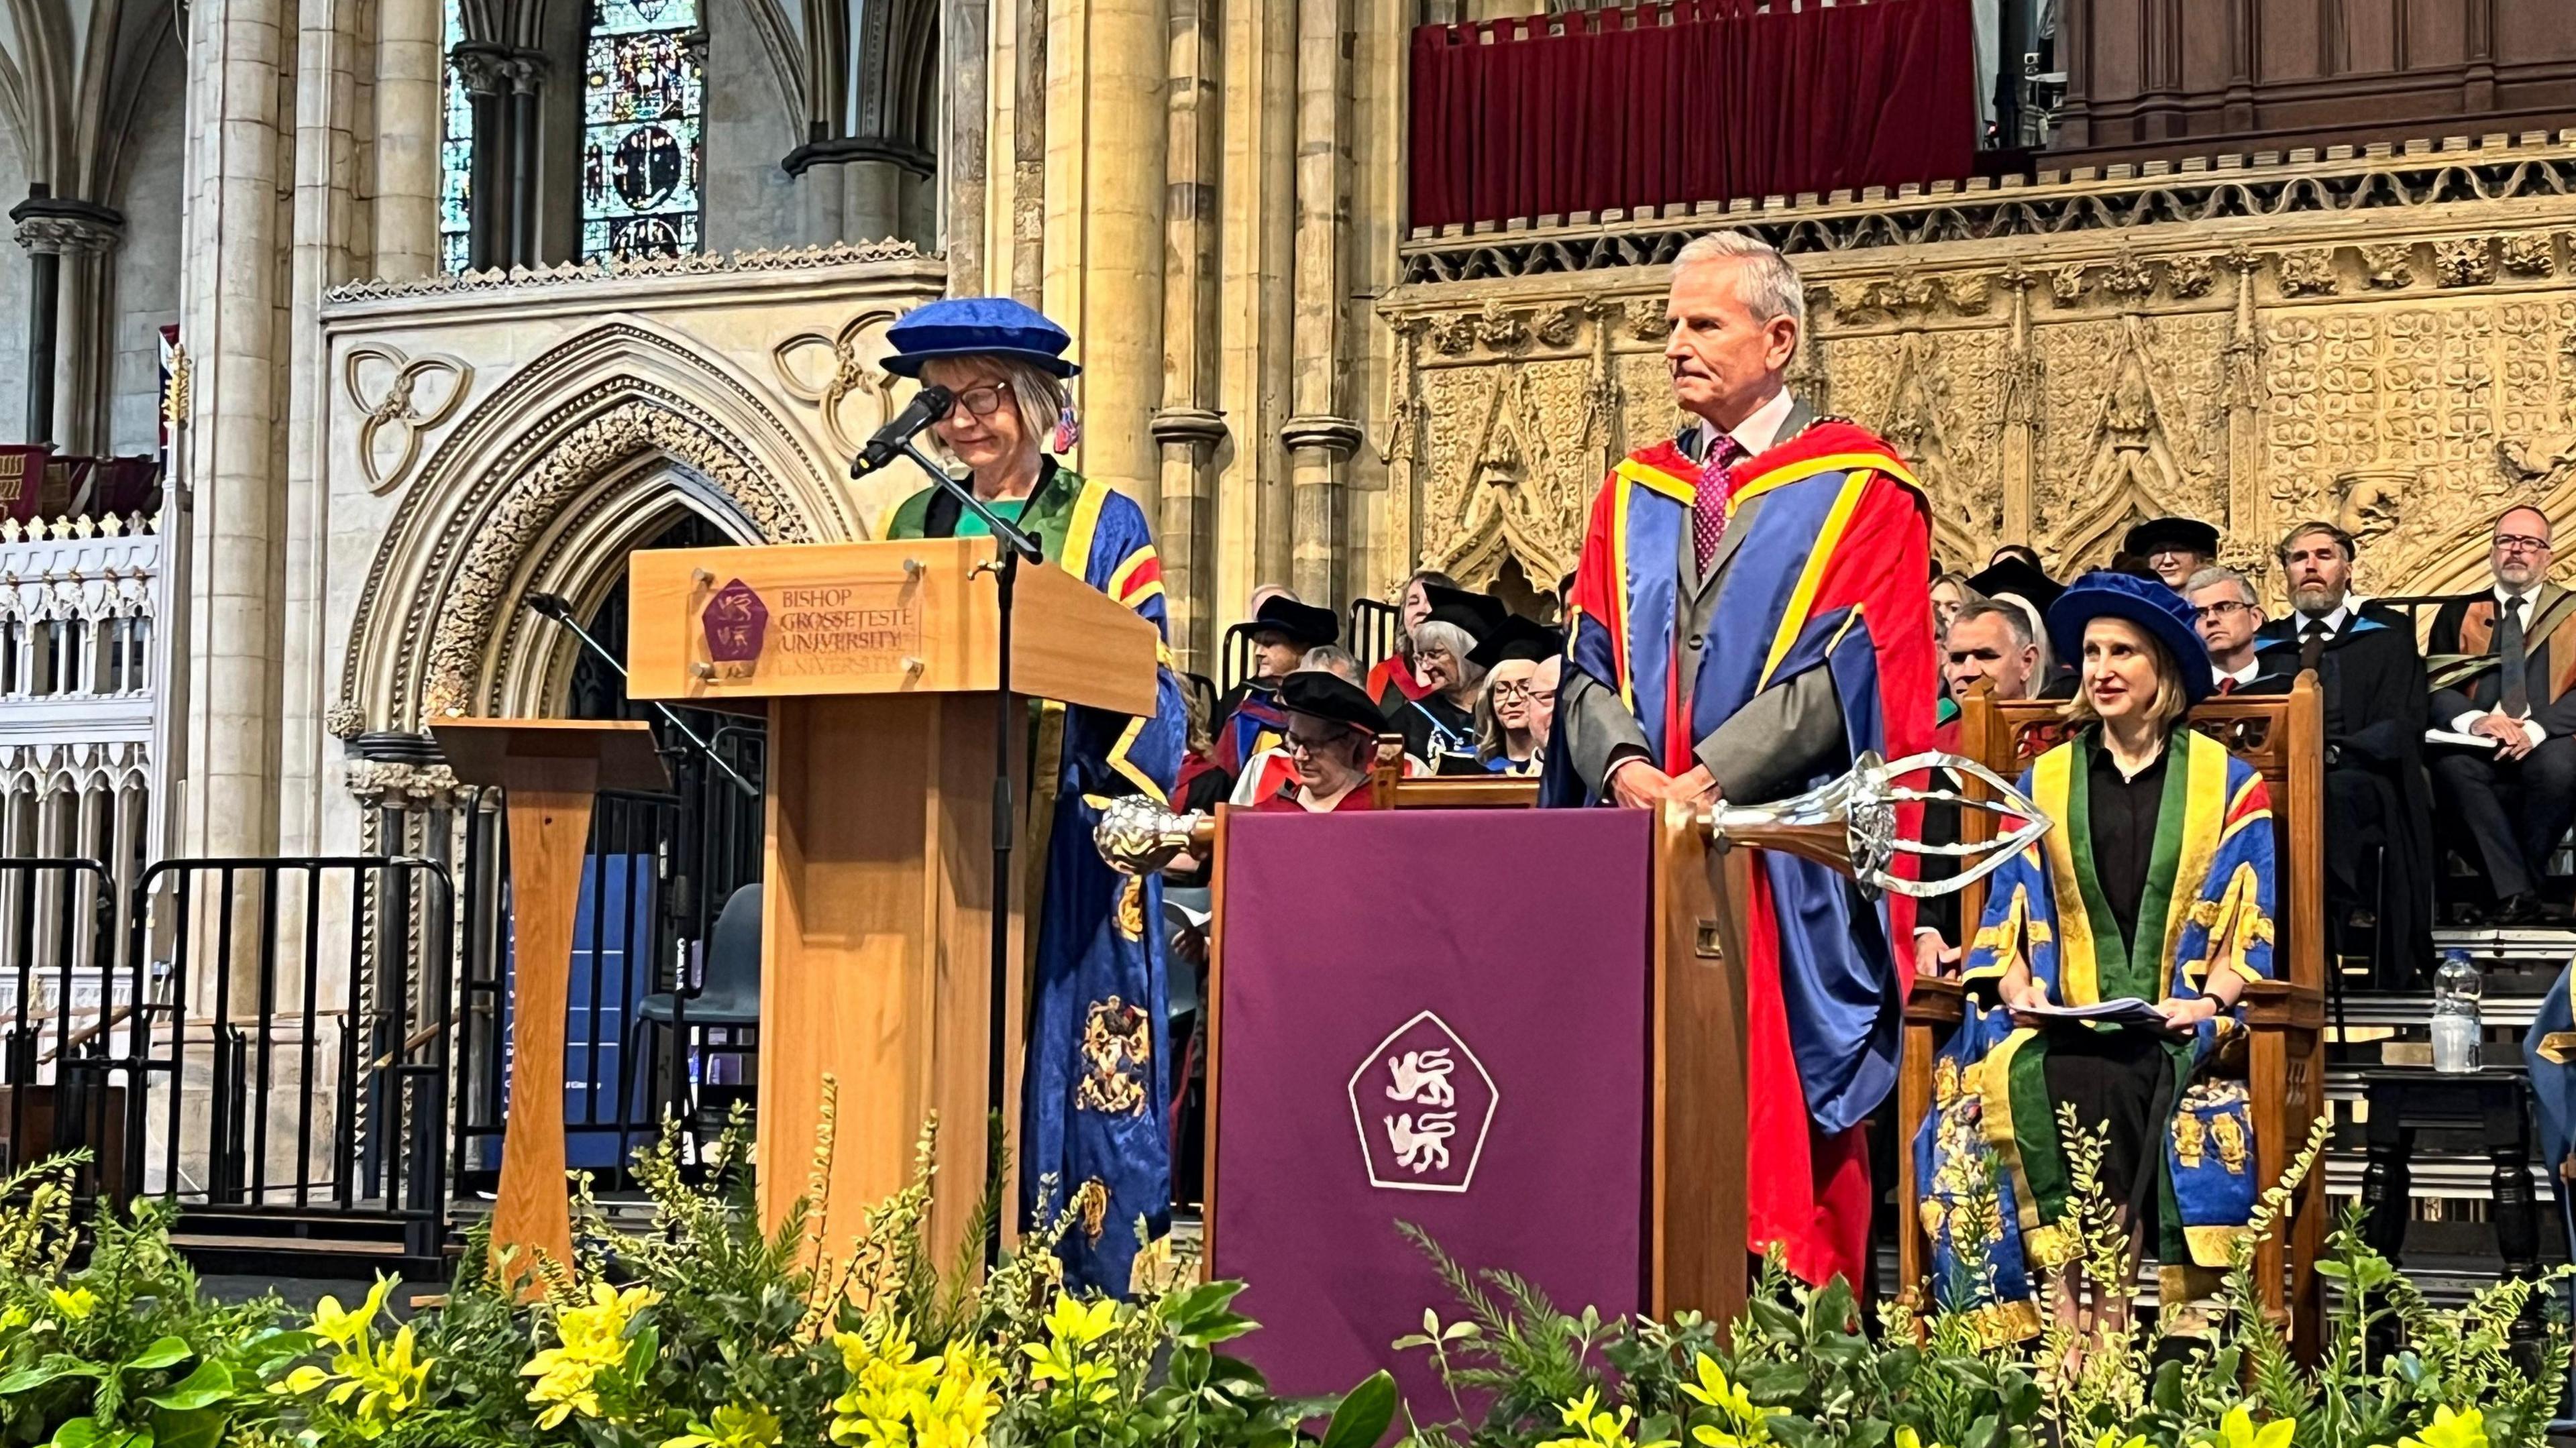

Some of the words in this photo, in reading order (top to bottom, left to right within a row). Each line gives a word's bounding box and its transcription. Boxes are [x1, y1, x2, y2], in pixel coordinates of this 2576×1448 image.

[782, 589, 853, 608] BISHOP
[780, 608, 914, 631] GROSSETESTE
[781, 630, 902, 653] UNIVERSITY
